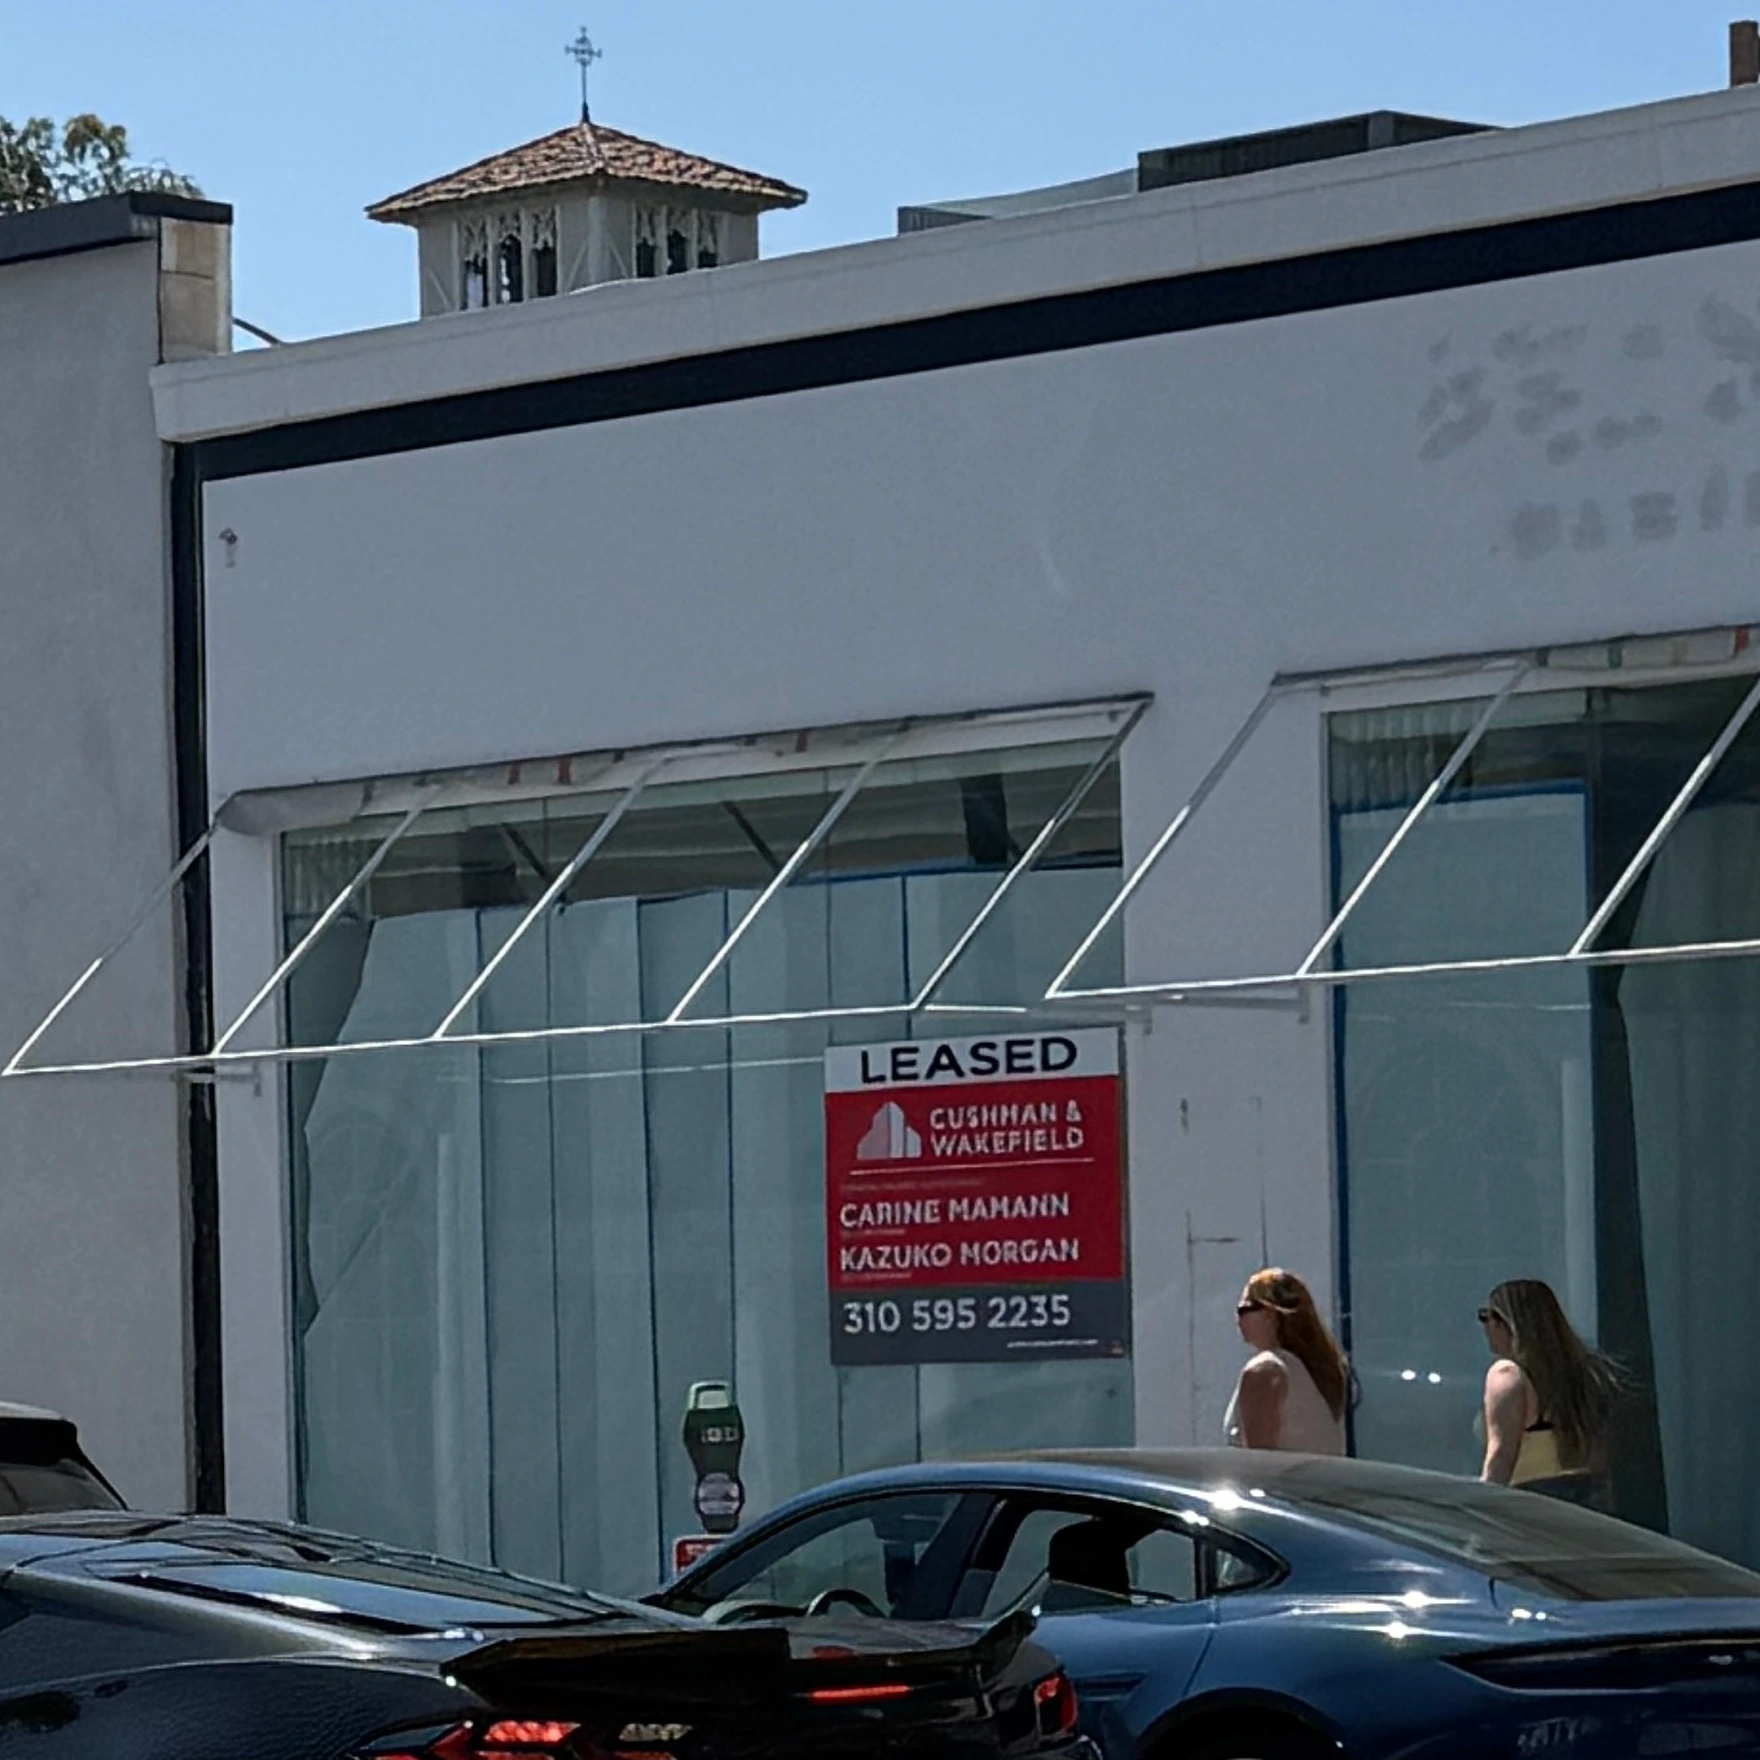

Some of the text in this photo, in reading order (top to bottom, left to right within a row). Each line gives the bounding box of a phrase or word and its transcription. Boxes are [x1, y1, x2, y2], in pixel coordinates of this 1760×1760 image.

[860, 1036, 1078, 1084] LEASED
[930, 1099, 1082, 1131] CUSHMAN &
[930, 1126, 1084, 1157] WAKEFIELD
[840, 1192, 1069, 1228] CARINE MAMANN
[840, 1238, 1079, 1271] KAZUKO MORGAN
[844, 1294, 1070, 1334] 310 595 2235
